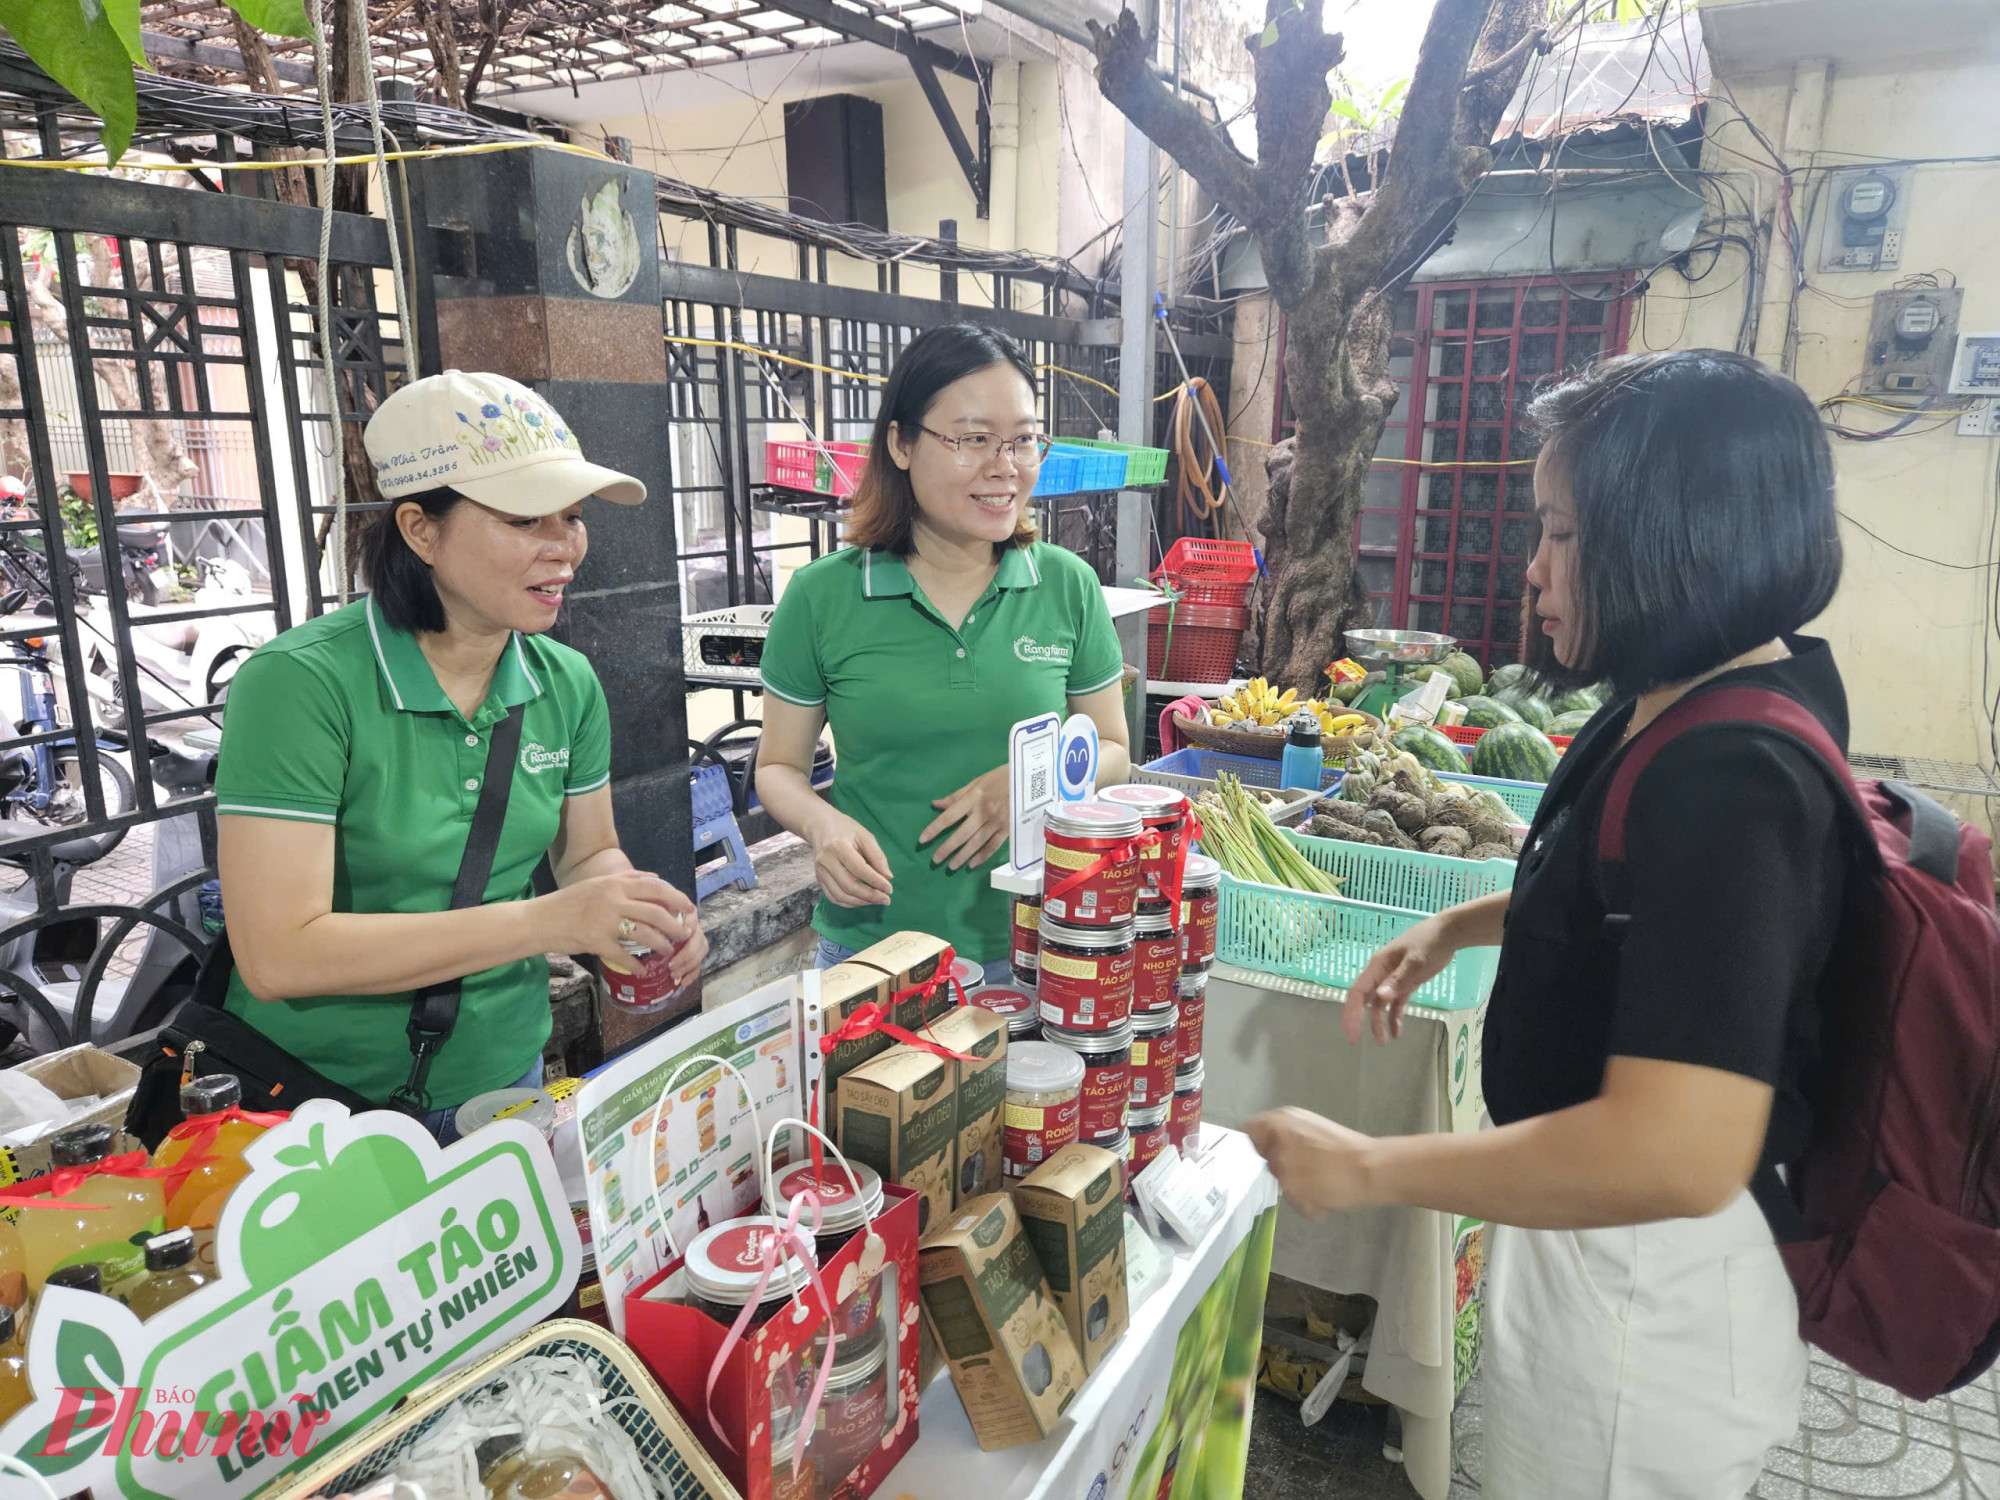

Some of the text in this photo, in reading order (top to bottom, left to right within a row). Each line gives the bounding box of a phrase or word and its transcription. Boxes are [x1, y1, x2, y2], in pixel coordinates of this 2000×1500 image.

[1101, 869, 1121, 880] TÁO
[1143, 955, 1177, 971] NHO ĐỎ
[1098, 976, 1118, 987] TÁO
[1084, 1085, 1105, 1096] TÁO
[1045, 1122, 1074, 1140] RONG
[195, 1206, 521, 1437] GIẤM TÁO
[217, 1245, 539, 1482] LÊN MEN TỰ NHIÊN
[830, 1421, 857, 1438] TÁO
